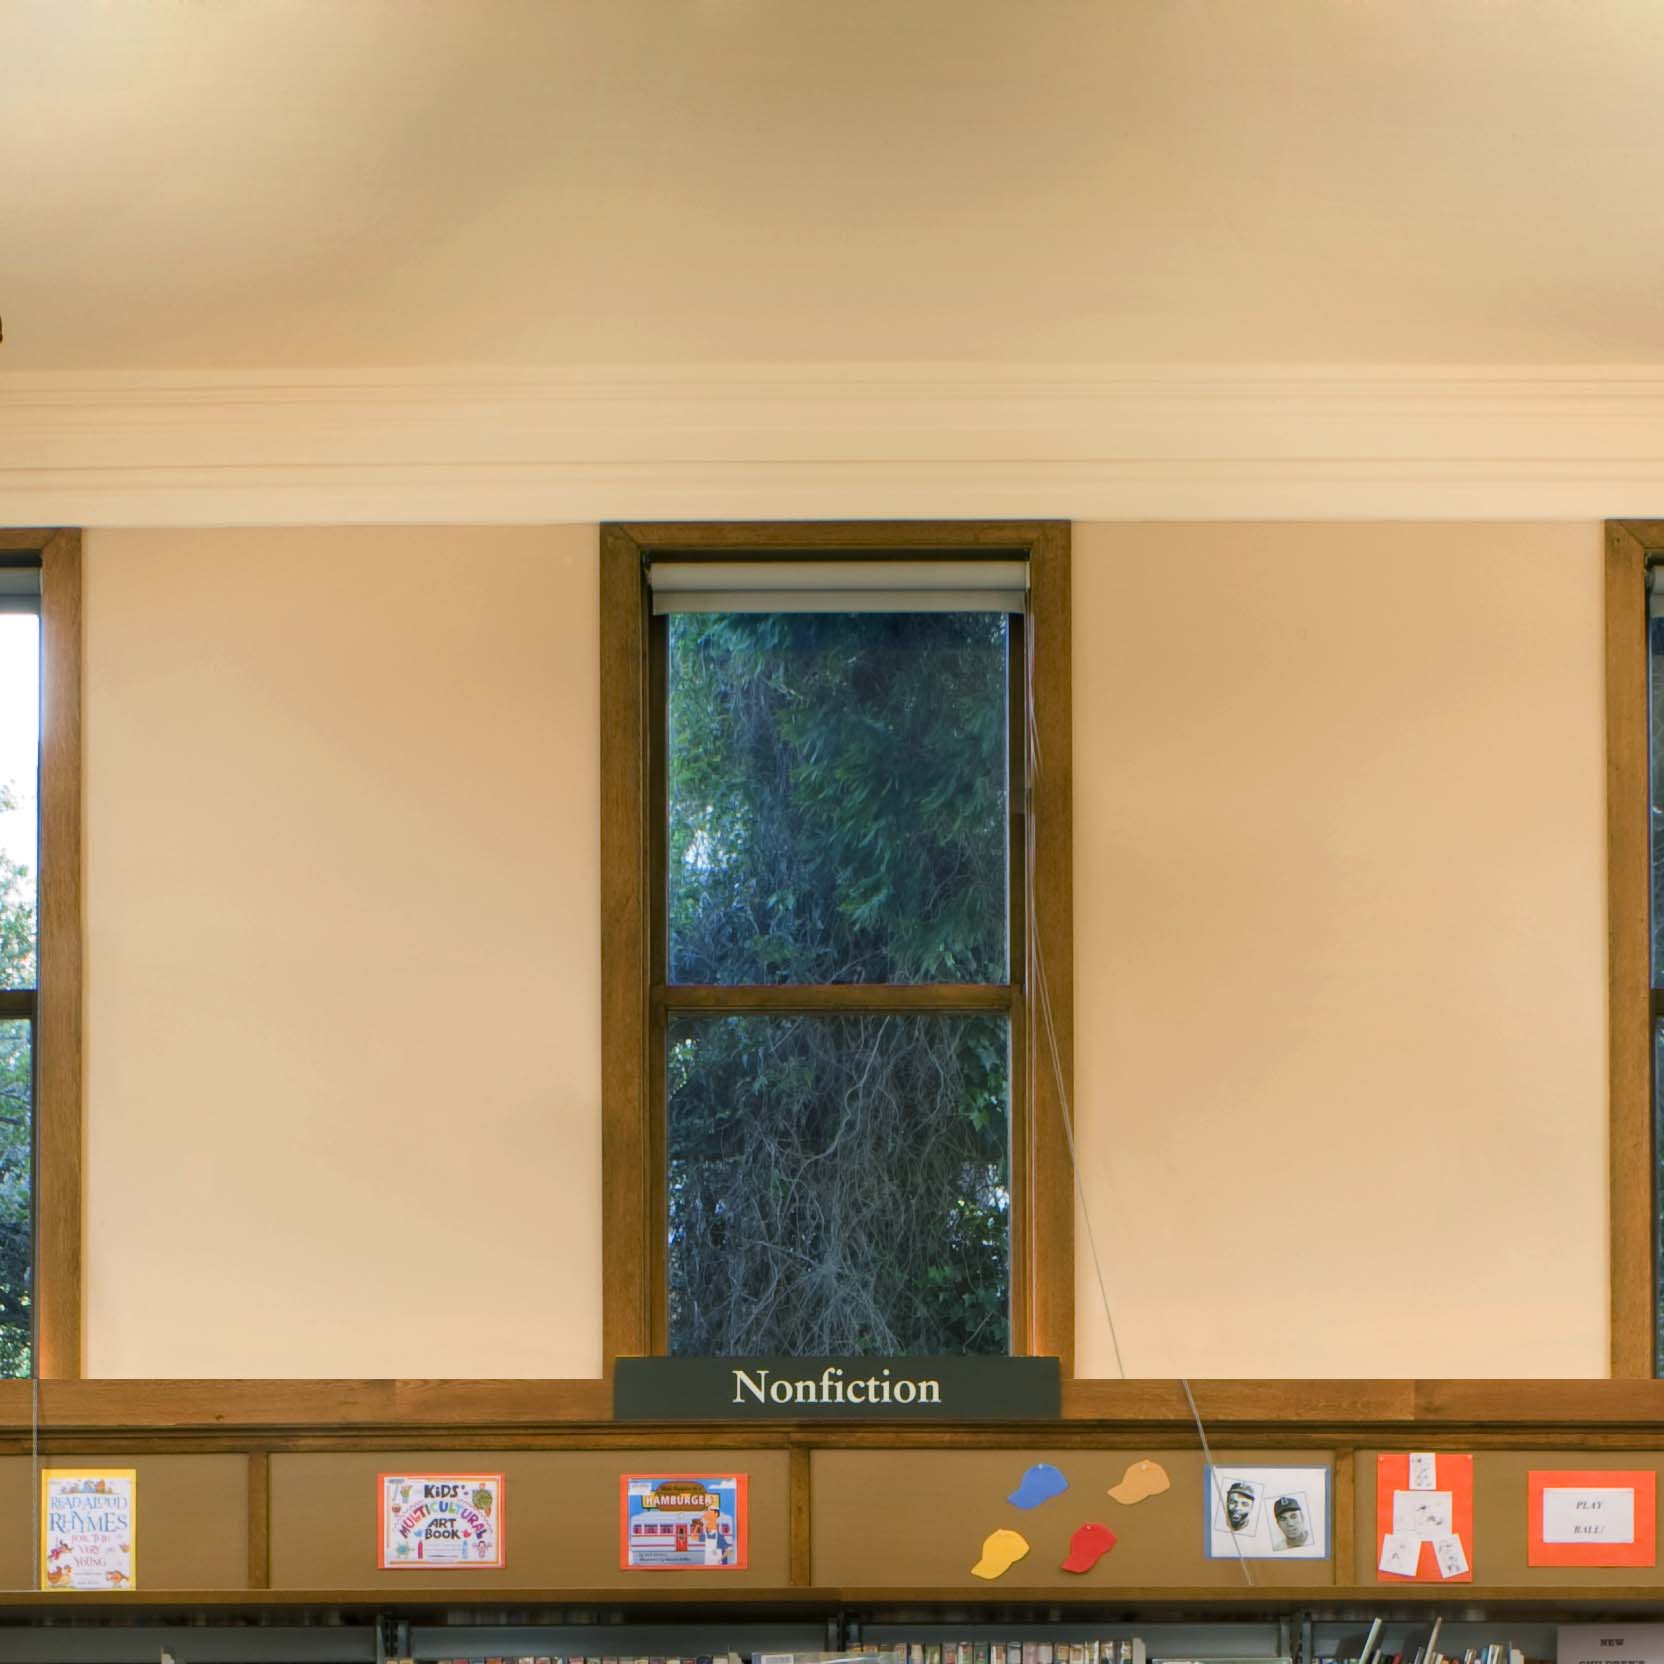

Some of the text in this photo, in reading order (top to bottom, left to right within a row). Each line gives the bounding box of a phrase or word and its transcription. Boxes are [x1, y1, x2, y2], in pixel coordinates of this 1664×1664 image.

[732, 1367, 942, 1403] Nonfiction
[1576, 1501, 1603, 1510] PLAY
[49, 1511, 129, 1533] RHYMES
[399, 1501, 488, 1539] MULTICULTURAL
[428, 1517, 457, 1529] ART
[424, 1528, 461, 1540] BOOK
[72, 1555, 106, 1568] YOUNG
[1599, 1638, 1624, 1647] NEW
